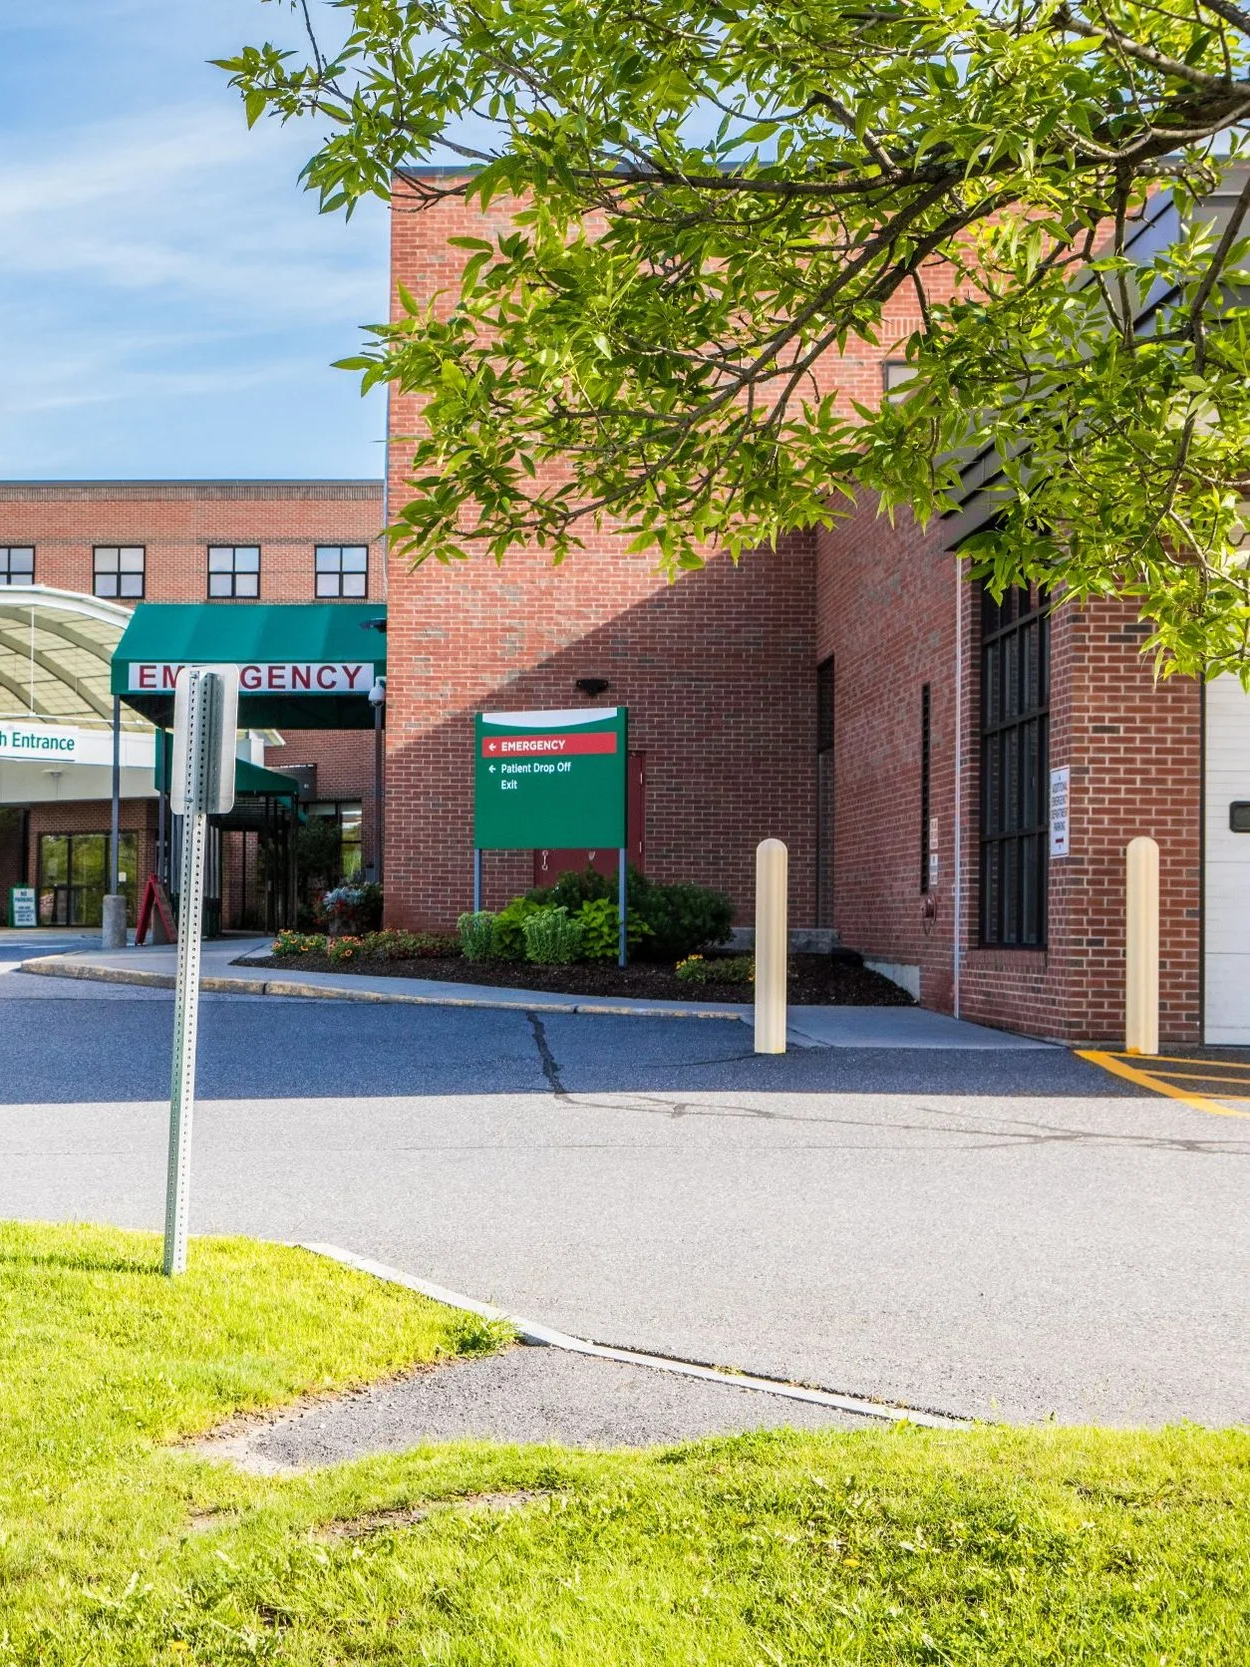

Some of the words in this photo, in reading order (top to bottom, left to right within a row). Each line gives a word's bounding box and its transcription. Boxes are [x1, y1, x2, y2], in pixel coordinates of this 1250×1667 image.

[138, 664, 364, 690] EMGENCY
[12, 731, 75, 751] Entrance
[501, 739, 566, 752] EMERGENCY
[501, 763, 531, 774] Patient
[533, 763, 555, 774] Drop
[557, 761, 572, 773] Off
[501, 779, 518, 790] Exit
